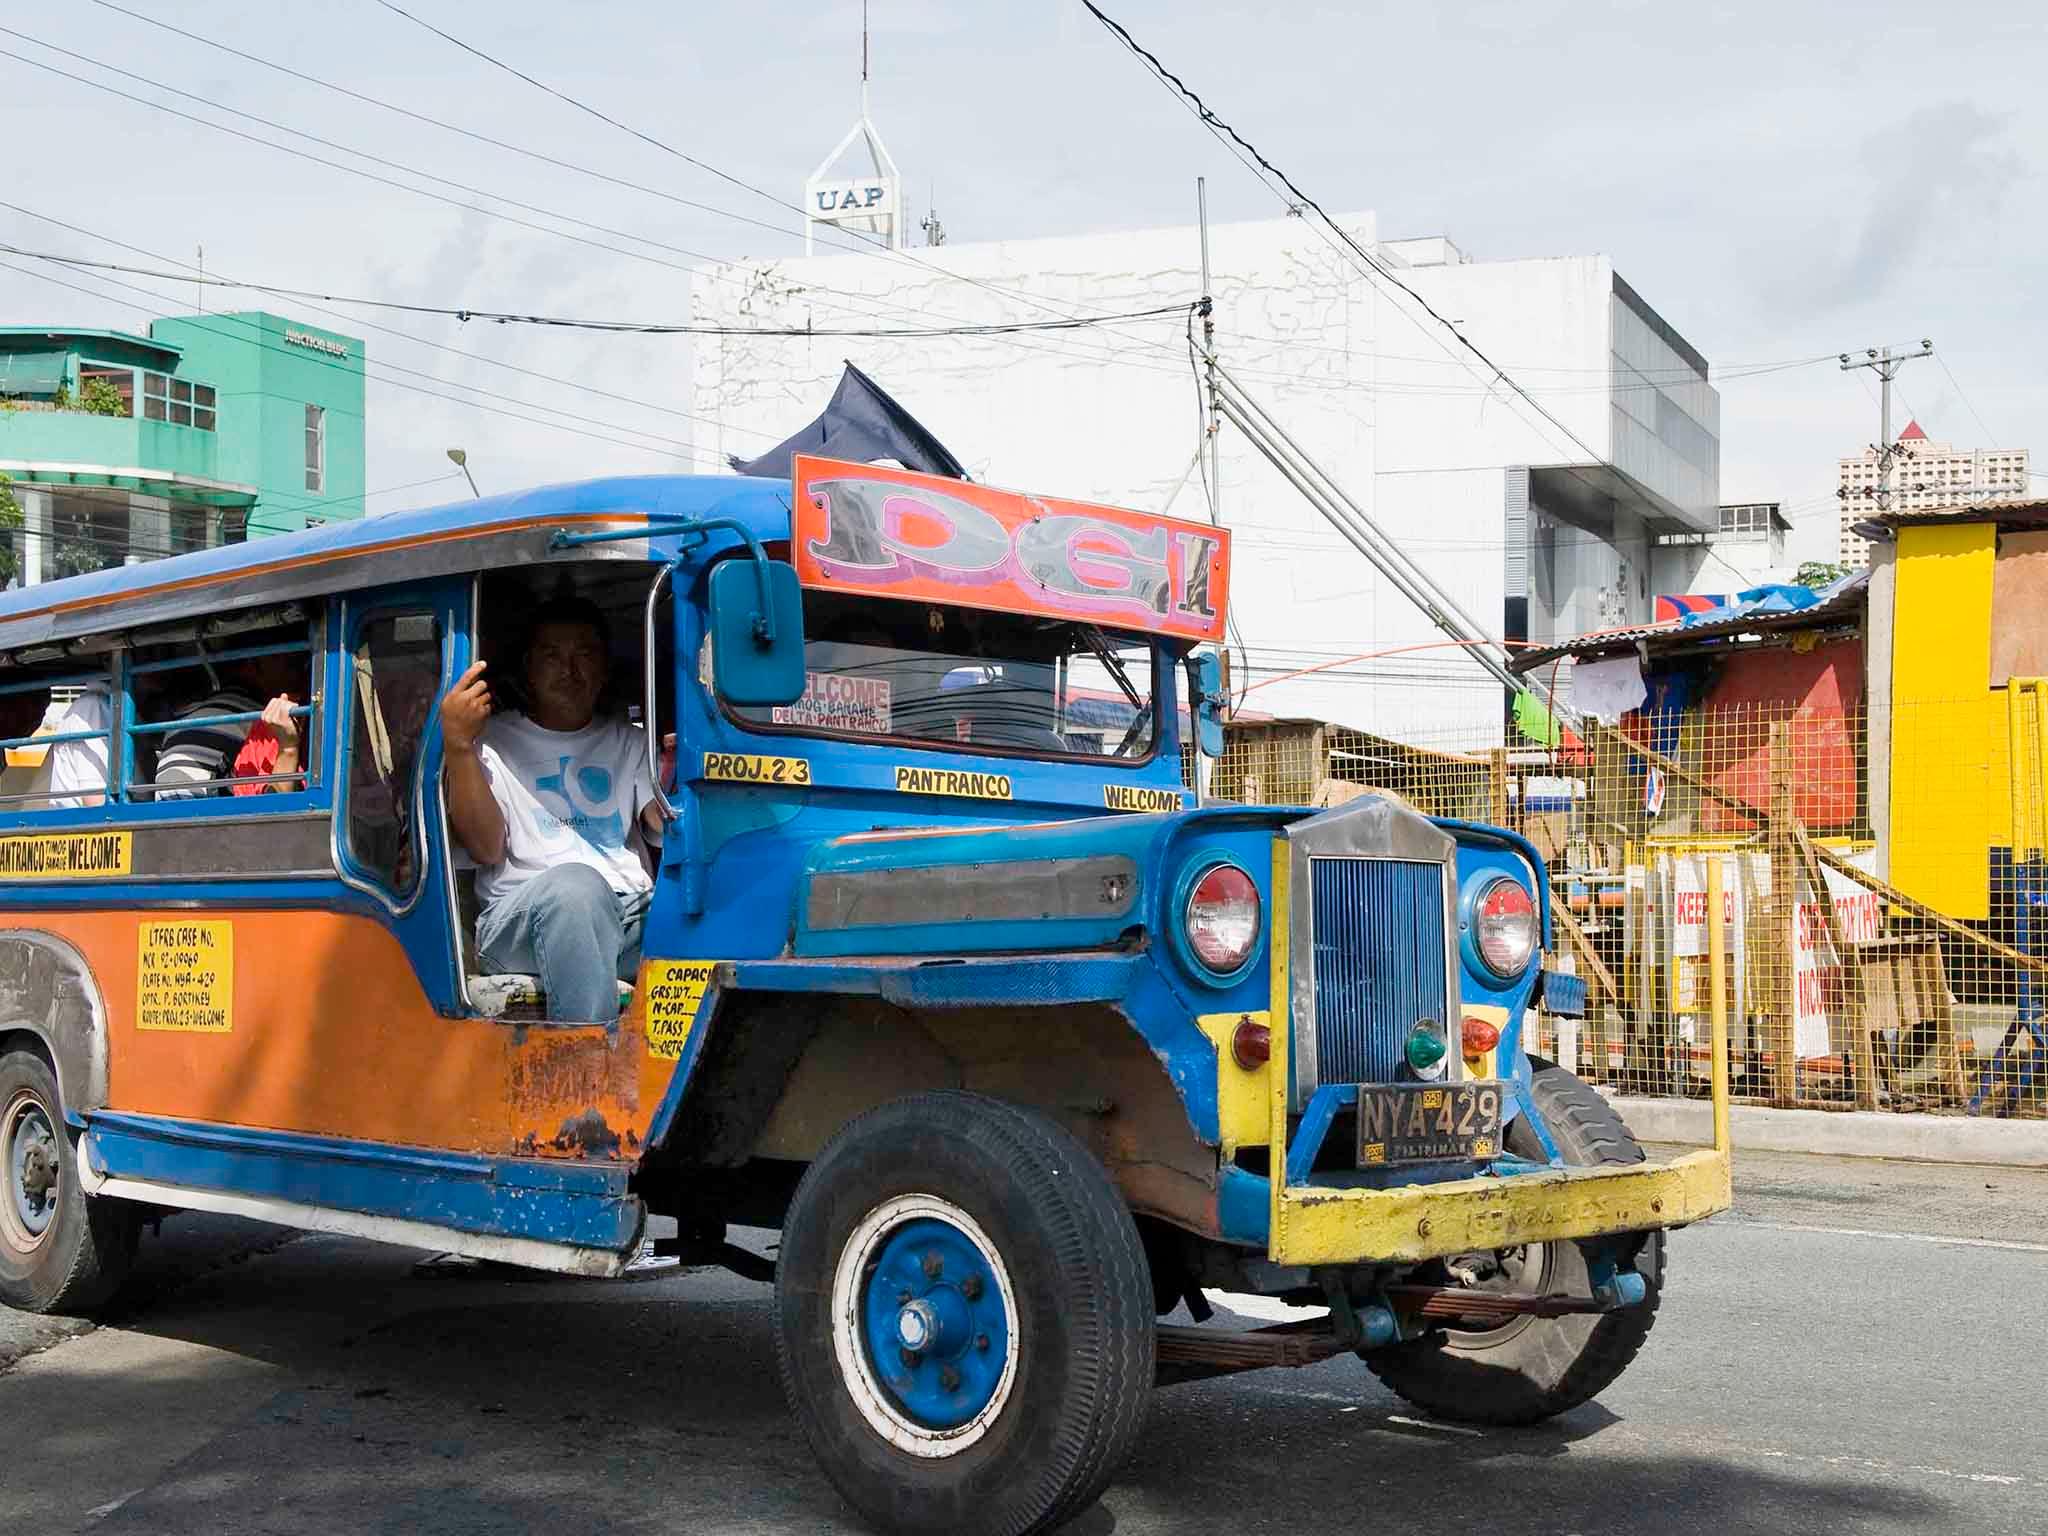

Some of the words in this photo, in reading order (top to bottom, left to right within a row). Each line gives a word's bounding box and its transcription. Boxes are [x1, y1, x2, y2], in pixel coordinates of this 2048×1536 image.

[816, 187, 884, 210] UAP
[804, 673, 888, 709] ELCOME
[896, 767, 1011, 798] PANTRANCO
[1105, 785, 1183, 812] WELCOME
[0, 841, 45, 872] ANTRANCO
[68, 836, 121, 870] WELCOME
[149, 927, 175, 948] LTFRB
[177, 927, 197, 947] CASE
[142, 973, 160, 988] PLATE
[666, 967, 713, 983] CAPACI
[1362, 1090, 1426, 1140] NYA
[1435, 1090, 1499, 1136] 429
